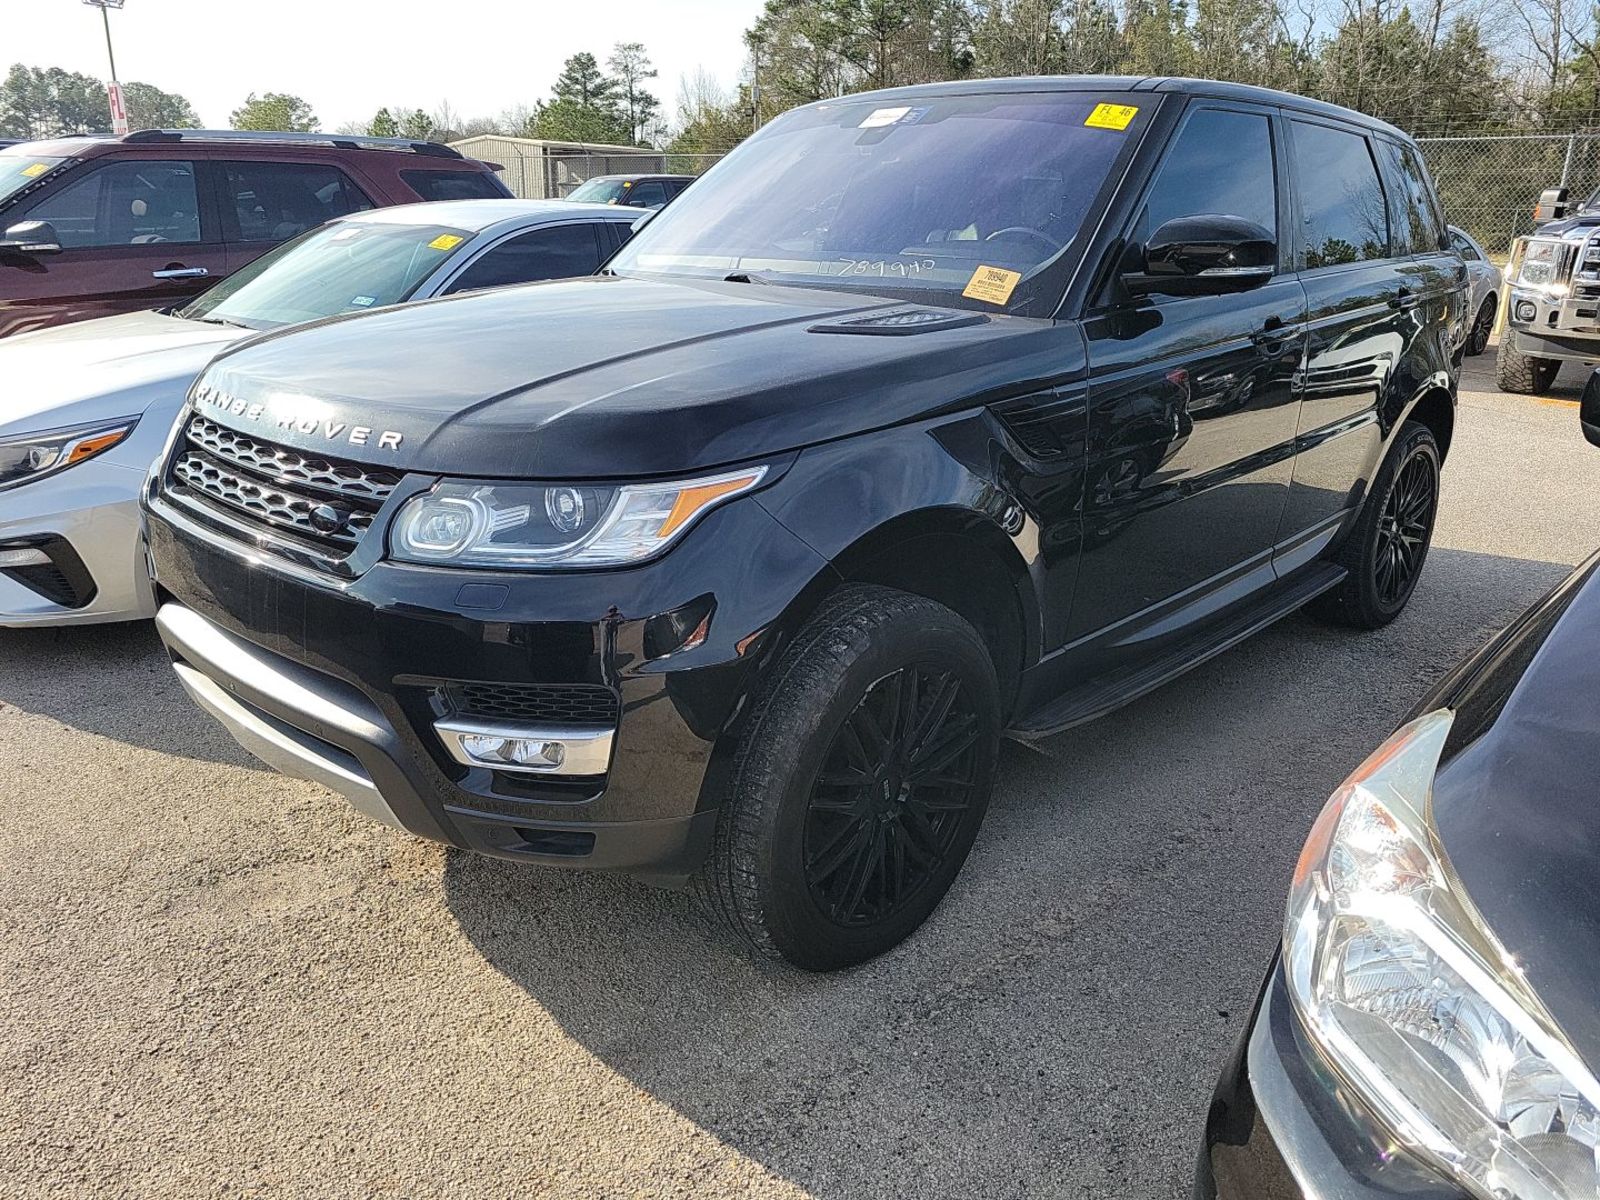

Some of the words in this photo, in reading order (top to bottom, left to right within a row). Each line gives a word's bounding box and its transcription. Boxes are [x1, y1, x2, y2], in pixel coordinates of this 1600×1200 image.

[1100, 105, 1113, 114] FL
[1119, 107, 1133, 116] 46
[196, 385, 266, 421] RANGE
[276, 413, 404, 452] ROVER
